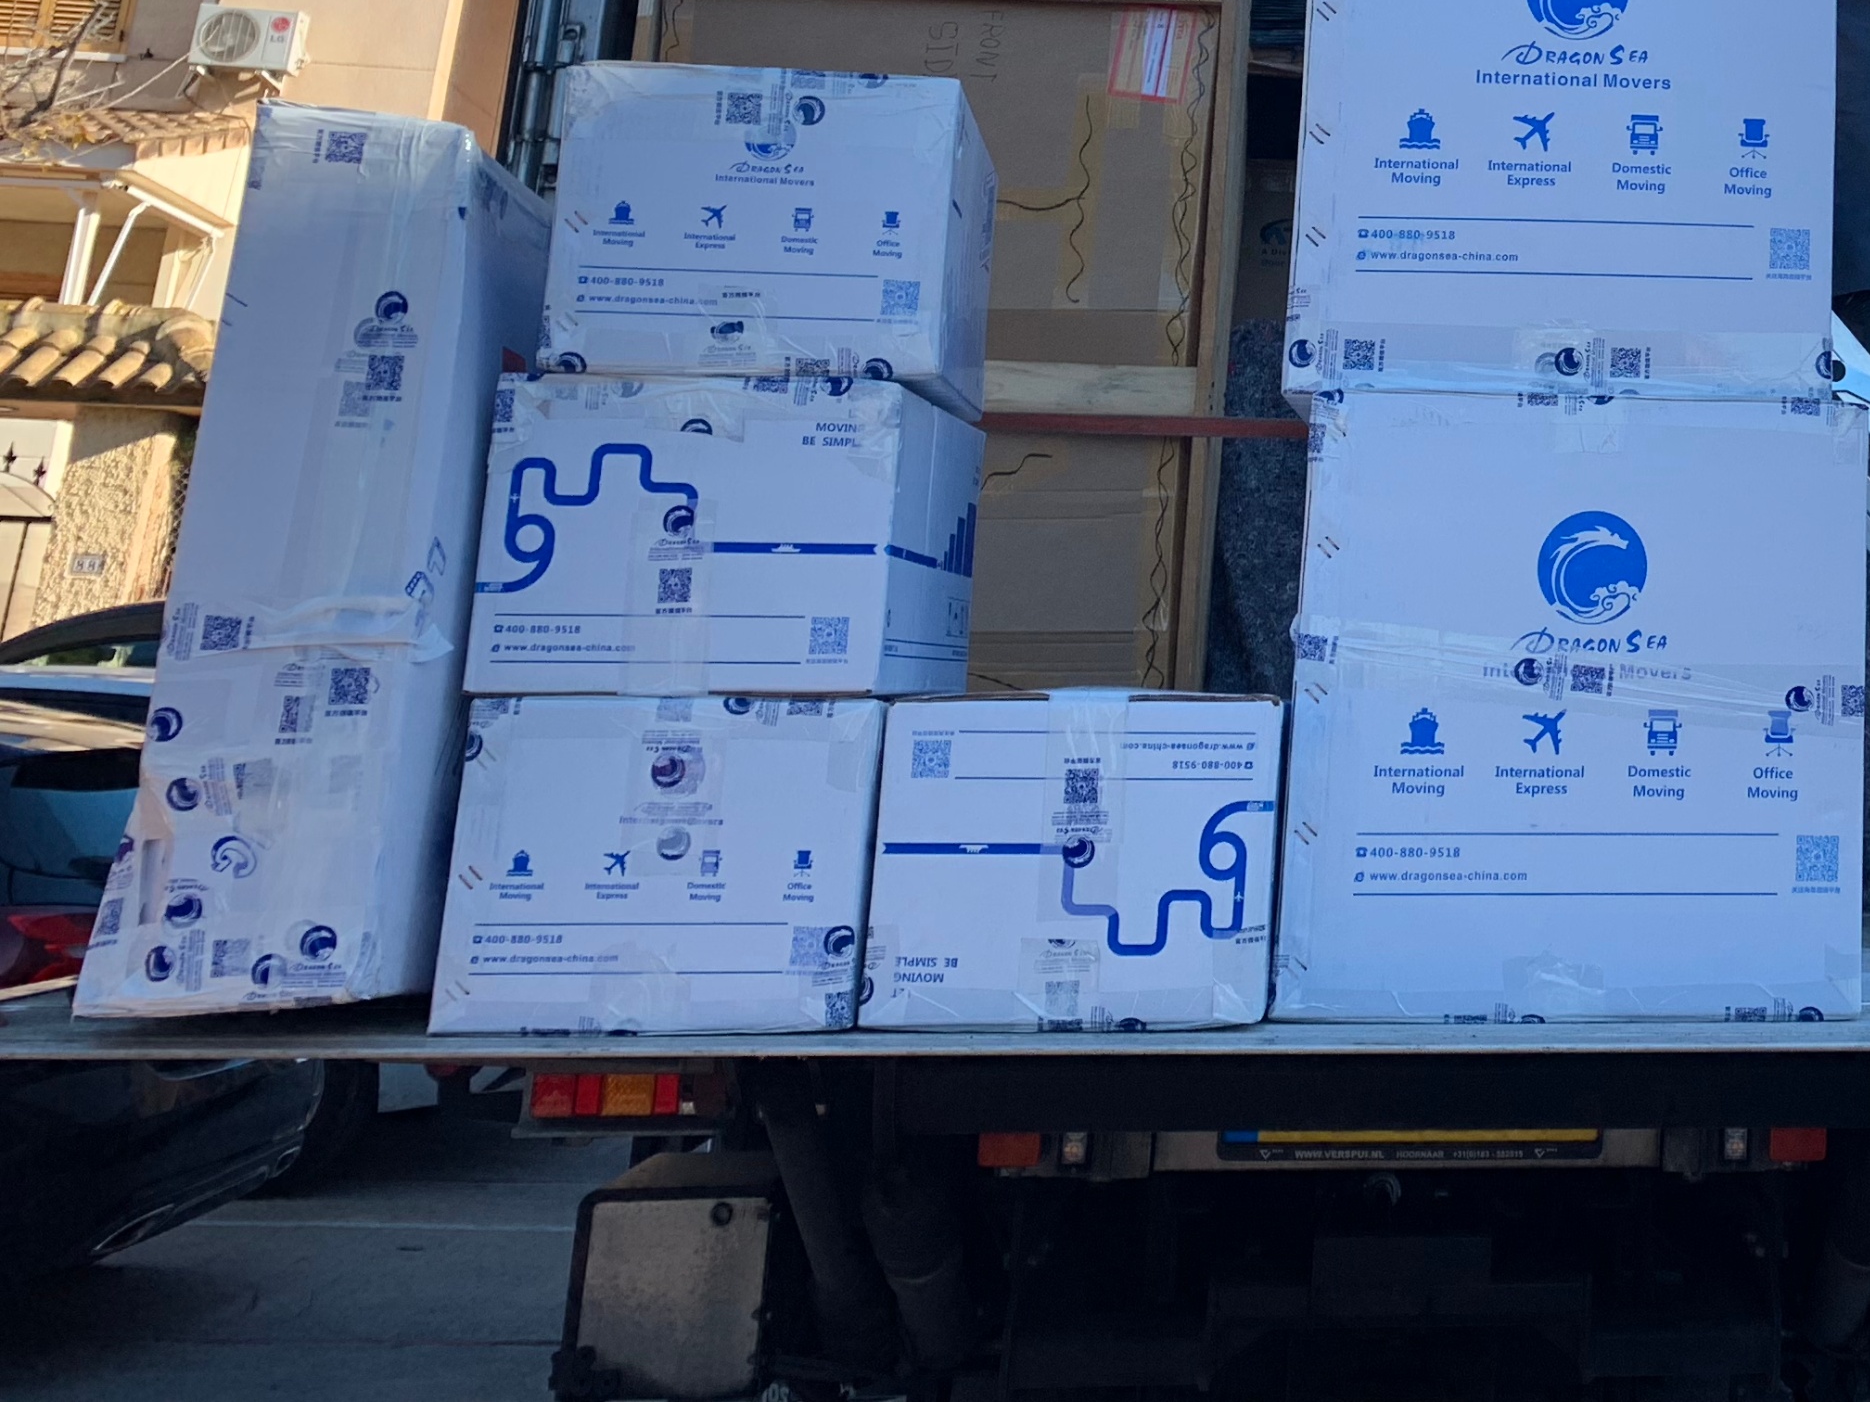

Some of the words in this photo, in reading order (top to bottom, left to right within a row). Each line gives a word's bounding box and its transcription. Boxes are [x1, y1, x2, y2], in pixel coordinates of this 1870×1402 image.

[269, 34, 286, 44] LG
[923, 21, 959, 77] SID
[1500, 40, 1605, 66] DRAGON
[1609, 44, 1649, 66] SEA
[1476, 69, 1598, 88] International
[1602, 73, 1672, 91] Movers
[1374, 157, 1459, 170] International
[1488, 159, 1572, 173] International
[1612, 162, 1672, 175] Domestic
[1729, 166, 1768, 179] Office
[715, 173, 778, 184] International
[780, 177, 815, 187] Movers
[1391, 172, 1441, 187] Moving
[1507, 174, 1556, 189] Express
[1616, 179, 1666, 195] Moving
[1723, 183, 1772, 199] Moving
[593, 229, 646, 238] International
[683, 232, 736, 241] International
[780, 235, 819, 244] Domestic
[1370, 228, 1457, 240] 400-880-9518
[602, 238, 634, 248] Moving
[695, 241, 726, 251] Express
[876, 239, 900, 248] Office
[783, 246, 815, 256] Moving
[872, 249, 903, 260] Moving
[1370, 250, 1519, 263] www.dragonsea-china.com
[591, 276, 665, 287] 400-880-9518
[801, 435, 816, 446] BE
[822, 436, 865, 448] SIMPL
[505, 624, 581, 635] 400-880-9518
[1509, 626, 1622, 655] DRAGON
[1625, 629, 1668, 654] SEA
[1172, 760, 1243, 770] 400-880-9518
[1373, 764, 1465, 779] International
[1494, 765, 1585, 779] International
[1627, 765, 1692, 778] Domestic
[1752, 766, 1794, 780] Office
[1391, 781, 1446, 798] Moving
[1515, 782, 1568, 798] Express
[1633, 784, 1685, 801] Moving
[1747, 786, 1798, 802] Moving
[1370, 846, 1461, 859] 400-880-9518
[1369, 870, 1528, 884] www.dragonsea-china.com
[489, 882, 544, 891] International
[584, 882, 640, 891] International
[687, 881, 727, 890] Domestic
[787, 882, 813, 890] Office
[499, 891, 533, 902] Moving
[596, 891, 628, 901] Express
[689, 893, 722, 903] Moving
[782, 893, 815, 903] Moving
[485, 934, 563, 944] 400-880-9518
[895, 956, 939, 968] SIMPLE
[944, 956, 959, 968] BE
[893, 972, 945, 984] MOVING
[1294, 1149, 1385, 1159] WWW.VERSPUI.NL
